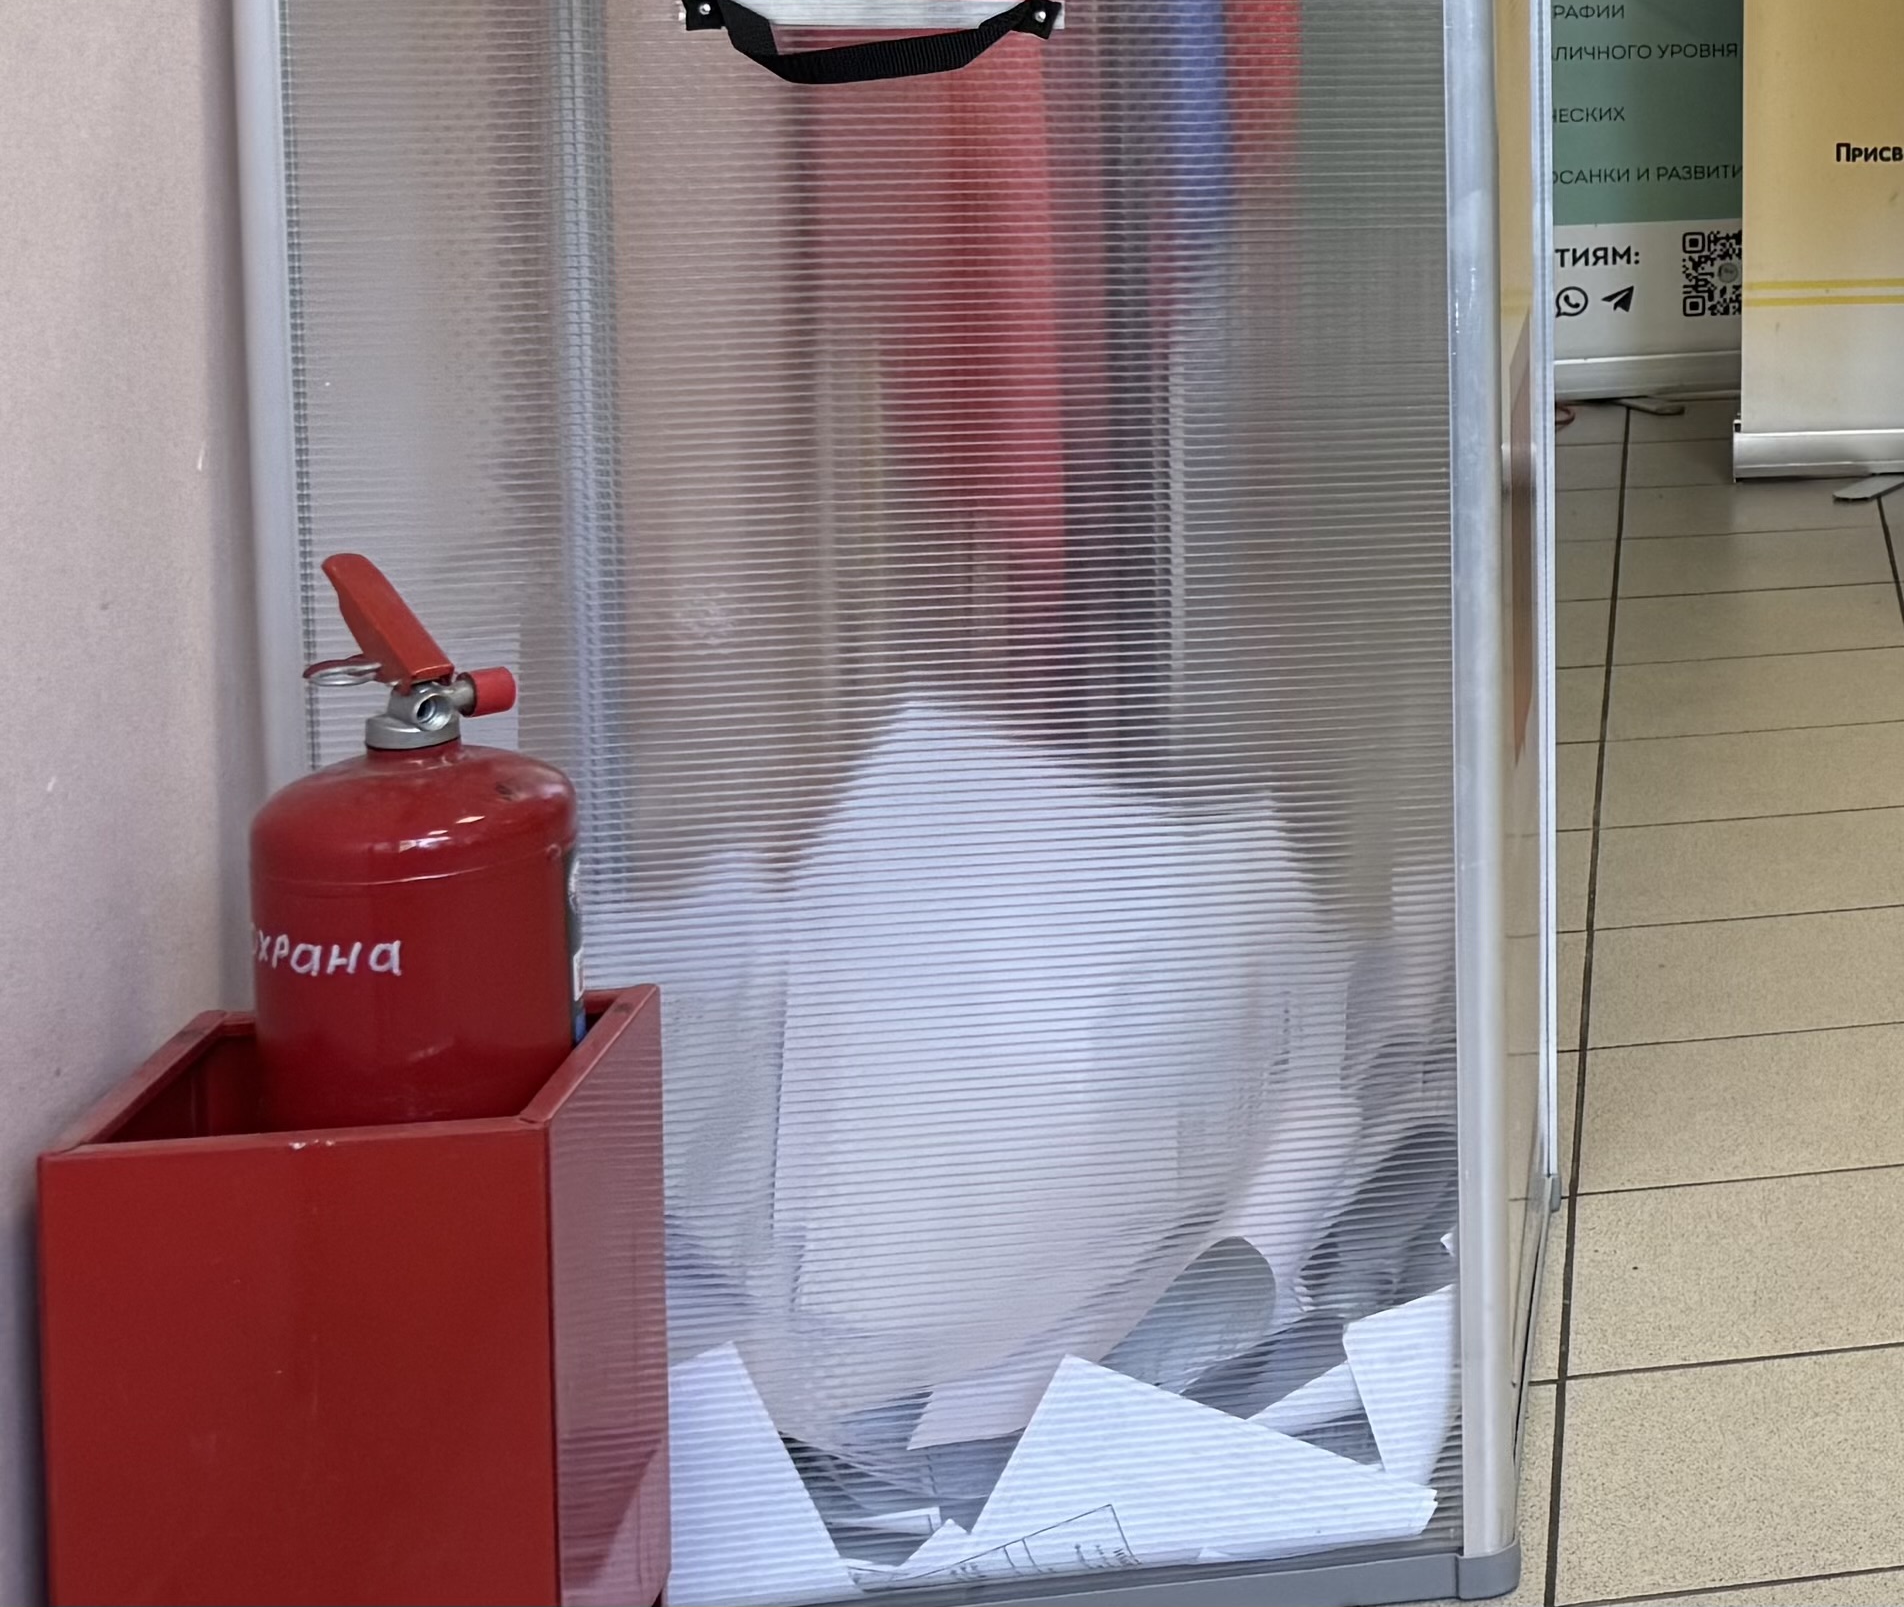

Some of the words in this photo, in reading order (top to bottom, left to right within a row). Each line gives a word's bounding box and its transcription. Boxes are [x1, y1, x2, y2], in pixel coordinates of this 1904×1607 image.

[1553, 4, 1625, 19] РАФИИ
[1552, 45, 1652, 61] ЛИЧНОГО
[1658, 43, 1738, 59] УРОВНЯ
[1637, 167, 1649, 182] И
[1657, 165, 1743, 181] РАЗВИТИ
[1555, 246, 1640, 268] ТИЯМ:
